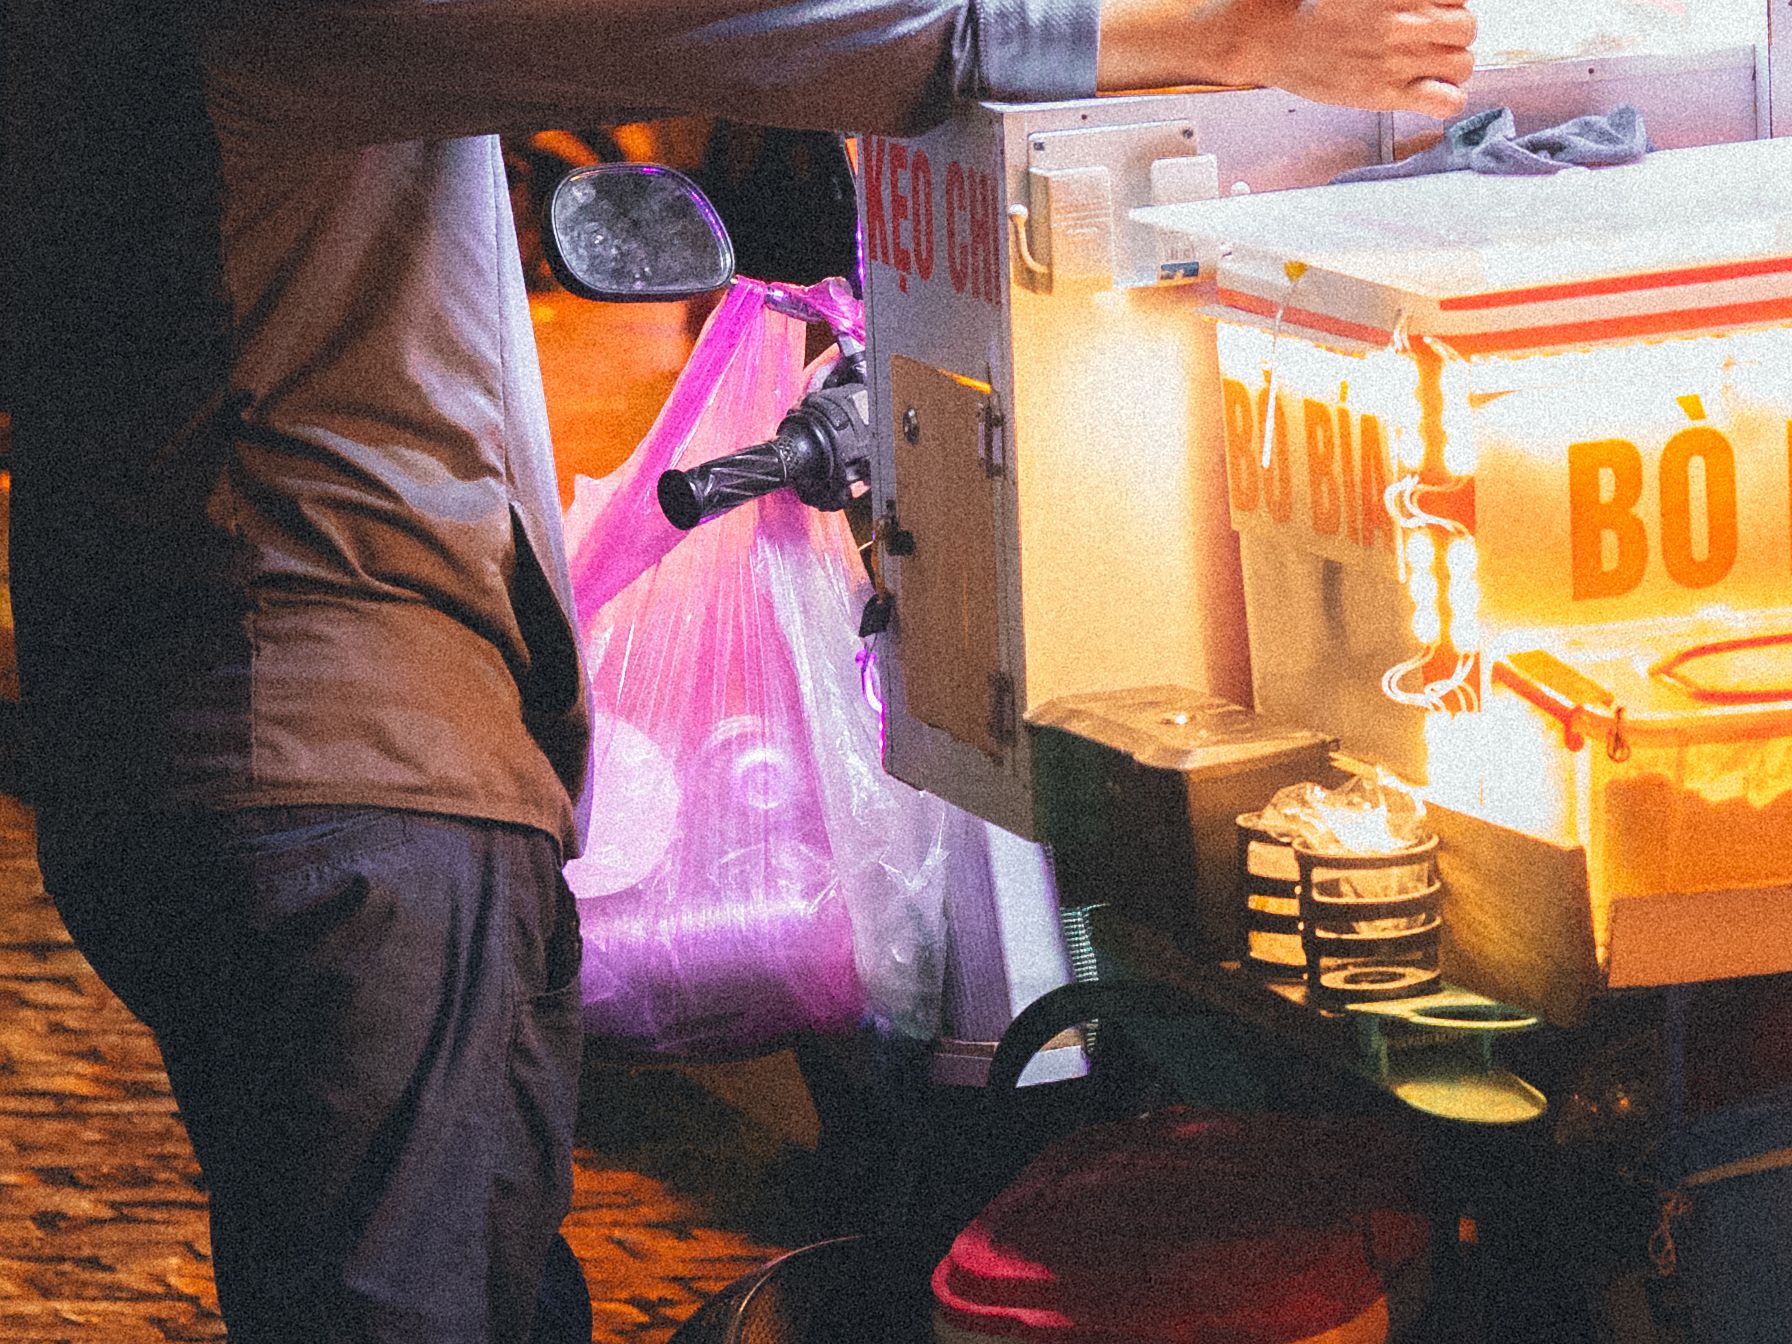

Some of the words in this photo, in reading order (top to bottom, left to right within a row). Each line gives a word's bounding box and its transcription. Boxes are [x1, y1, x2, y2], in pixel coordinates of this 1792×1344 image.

[863, 133, 934, 294] KẸO
[1302, 380, 1397, 551] BÍA
[1567, 393, 1739, 602] BÒ
